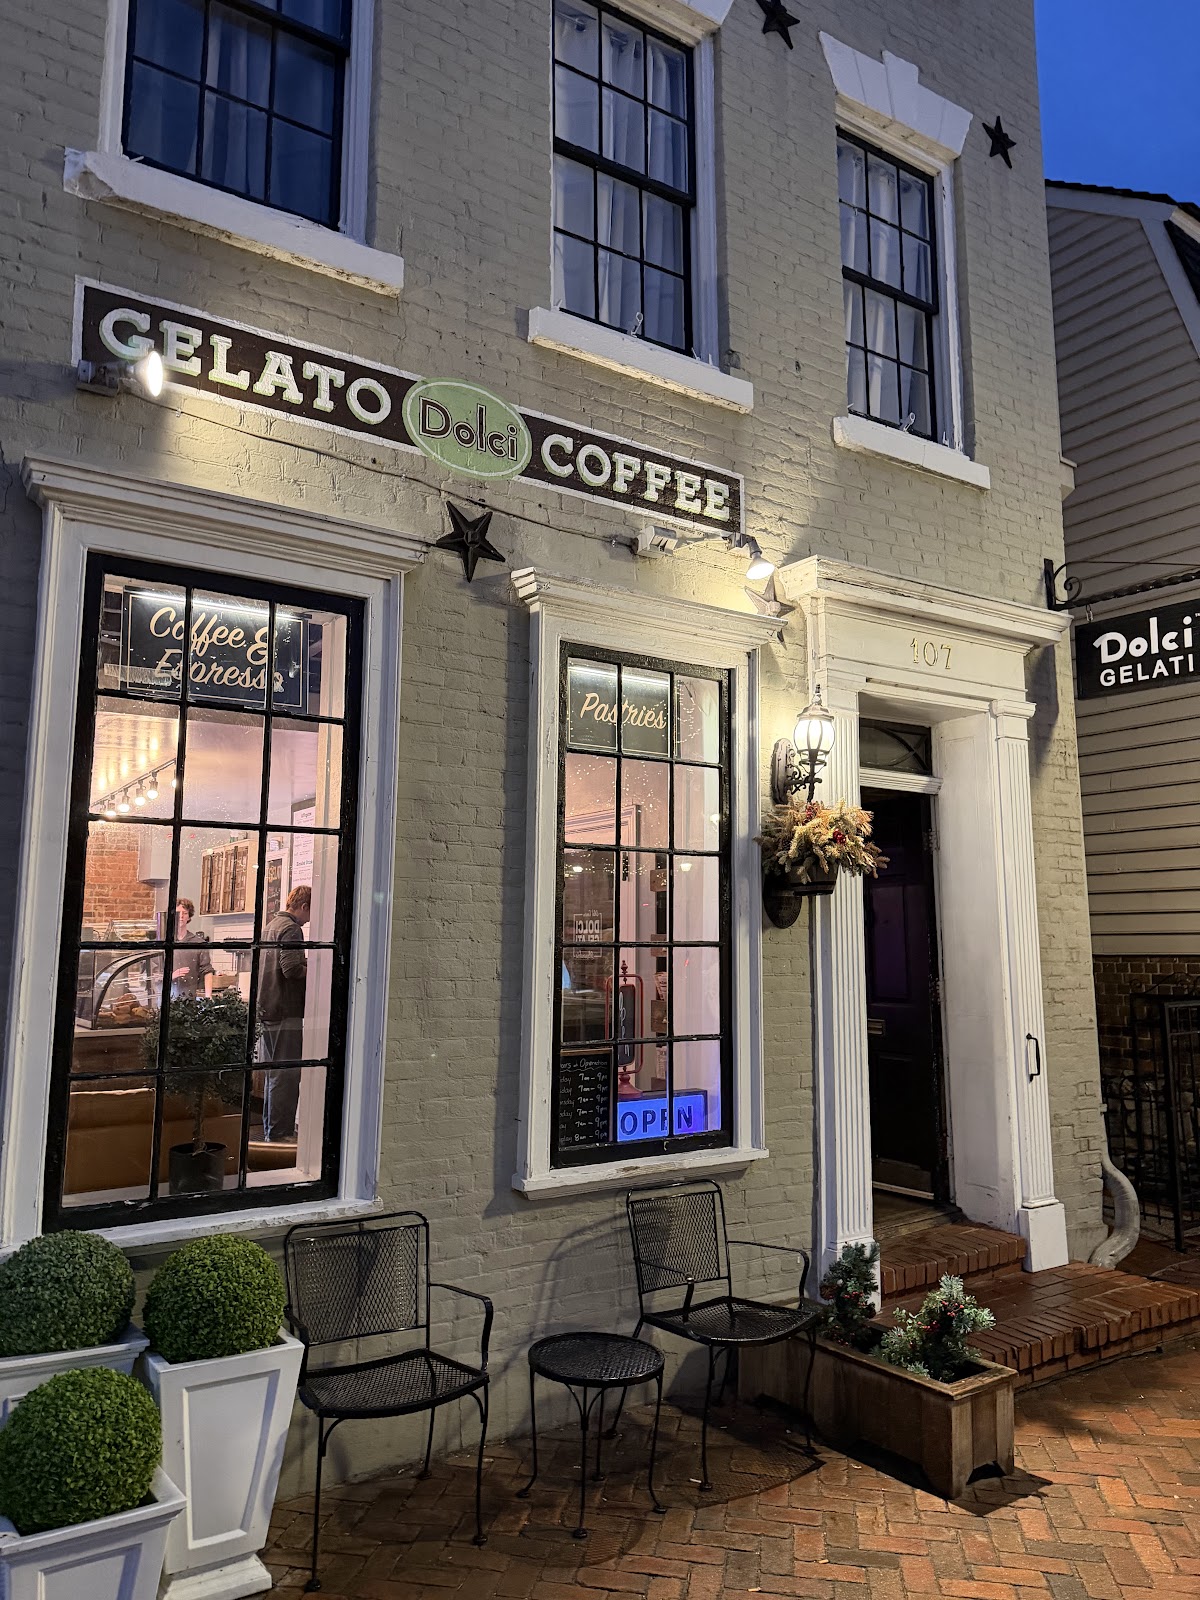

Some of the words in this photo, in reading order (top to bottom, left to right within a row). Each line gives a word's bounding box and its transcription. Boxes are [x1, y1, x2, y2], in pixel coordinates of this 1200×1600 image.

[98, 307, 392, 425] GELATO
[418, 396, 519, 462] Dolci
[541, 433, 731, 522] COFFEE
[149, 606, 247, 657] Coffee
[910, 637, 952, 670] 107
[1092, 616, 1193, 664] Dolci
[1100, 653, 1195, 687] GELATI
[579, 692, 667, 730] Pastries
[619, 1105, 693, 1136] OPEN
